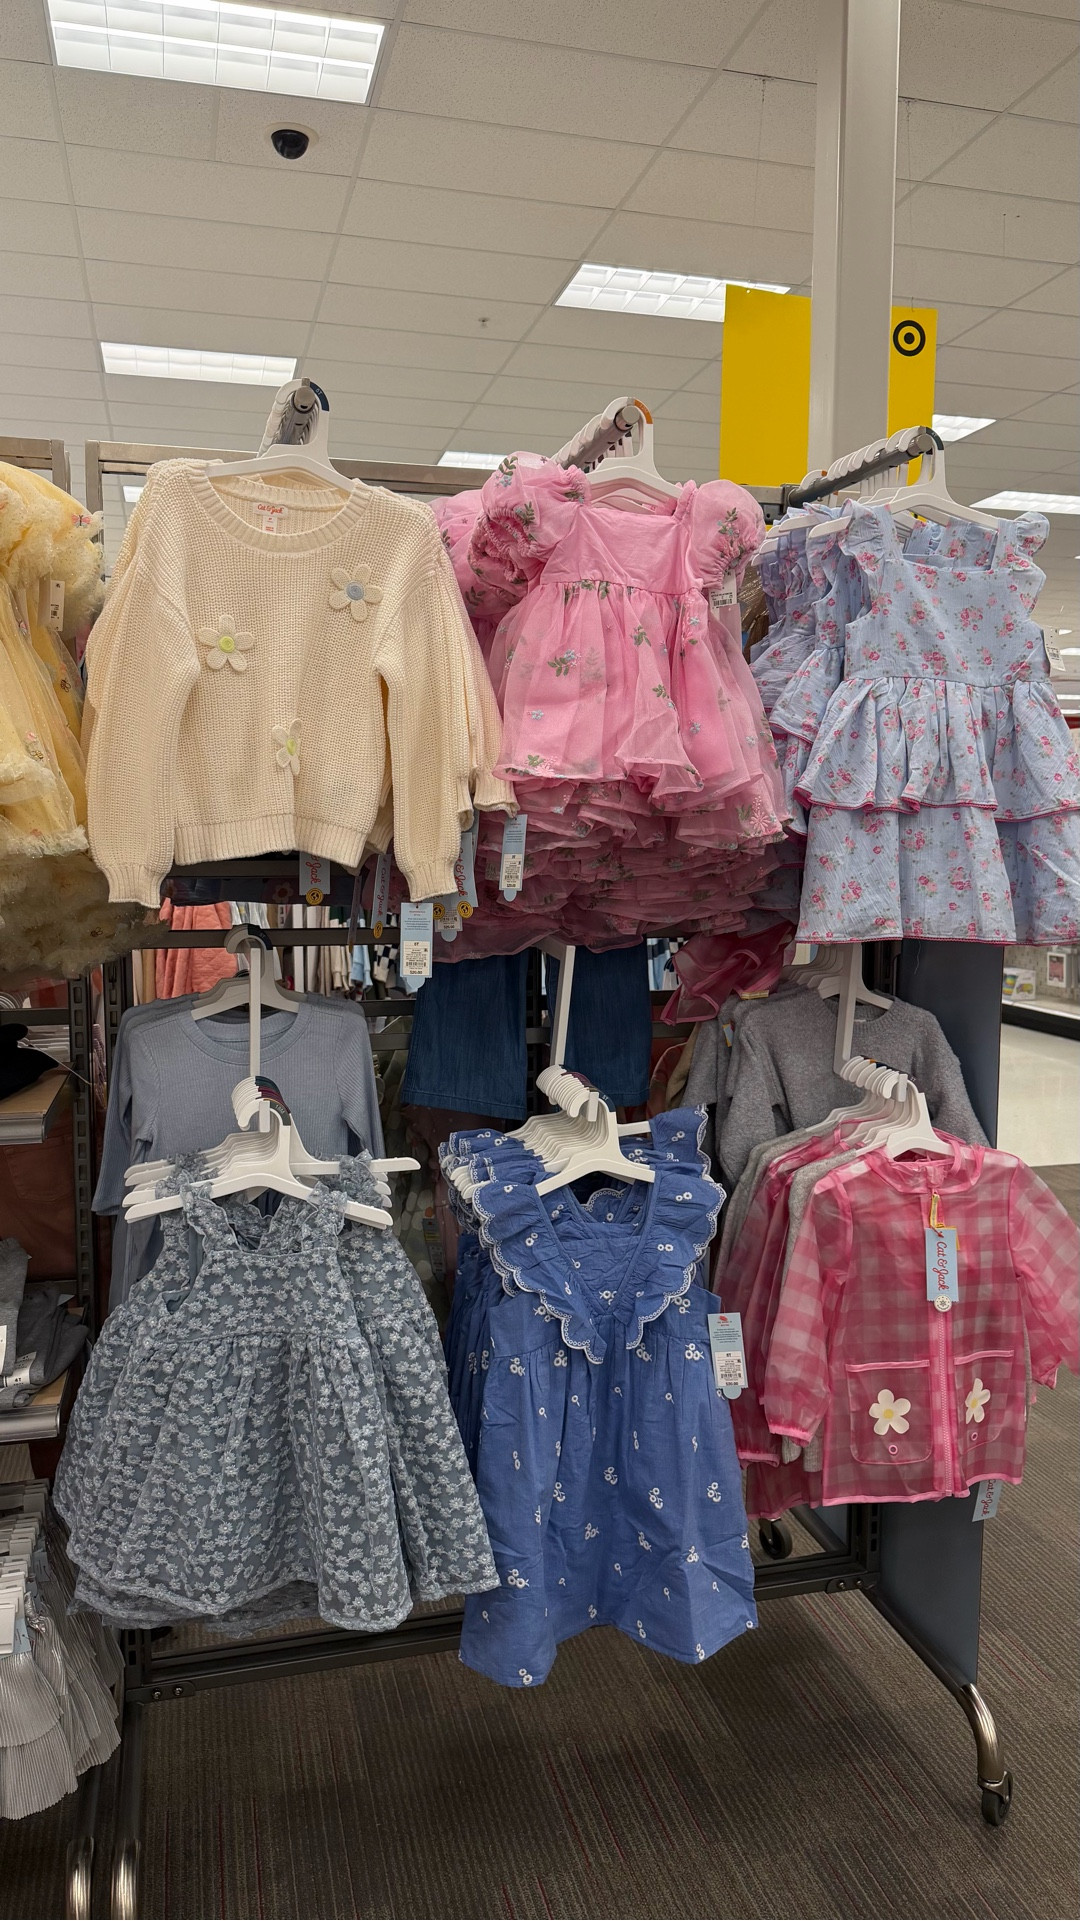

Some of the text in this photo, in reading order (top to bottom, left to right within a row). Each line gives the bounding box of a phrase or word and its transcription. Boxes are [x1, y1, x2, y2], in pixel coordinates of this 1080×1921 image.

[936, 1241, 947, 1258] Cat
[937, 1258, 948, 1268] &
[932, 1267, 950, 1291] Jack
